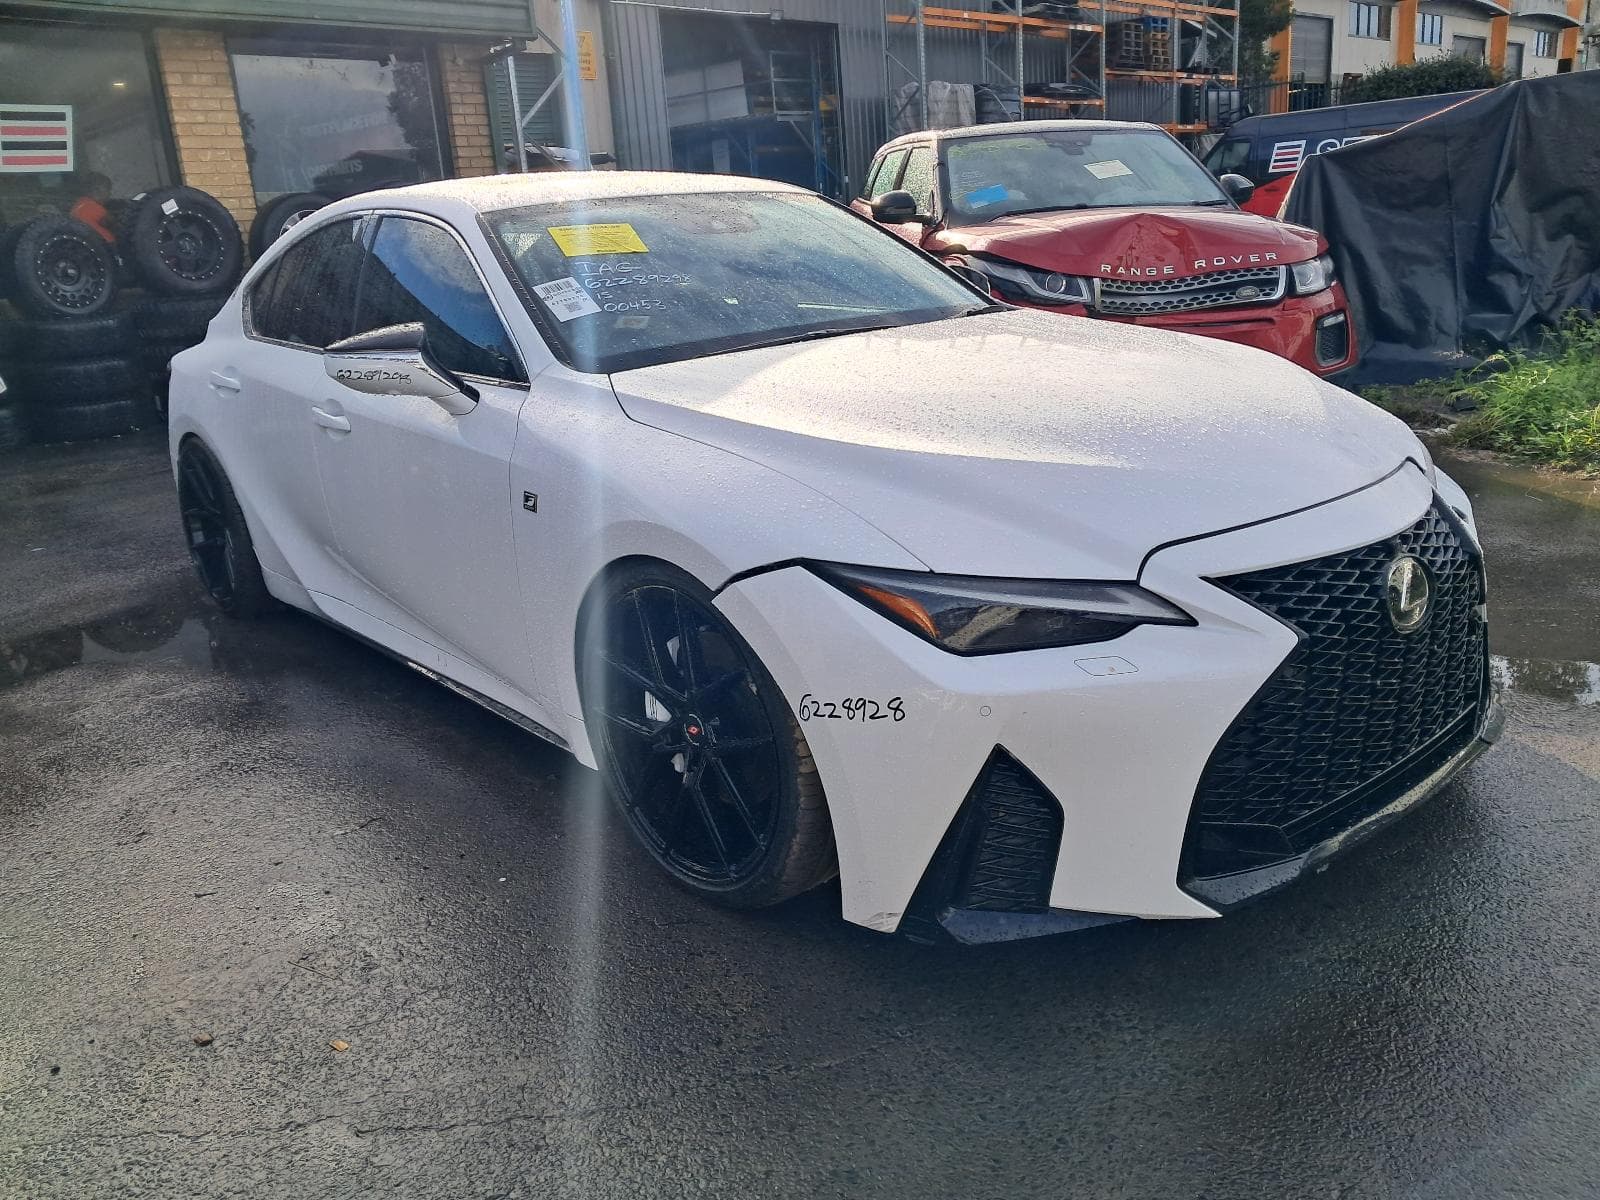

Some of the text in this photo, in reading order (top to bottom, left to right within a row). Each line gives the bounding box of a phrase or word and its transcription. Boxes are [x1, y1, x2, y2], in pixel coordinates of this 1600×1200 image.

[1100, 252, 1277, 276] RANGE ROVER
[603, 299, 667, 312] 00453
[799, 693, 906, 722] 6228928
